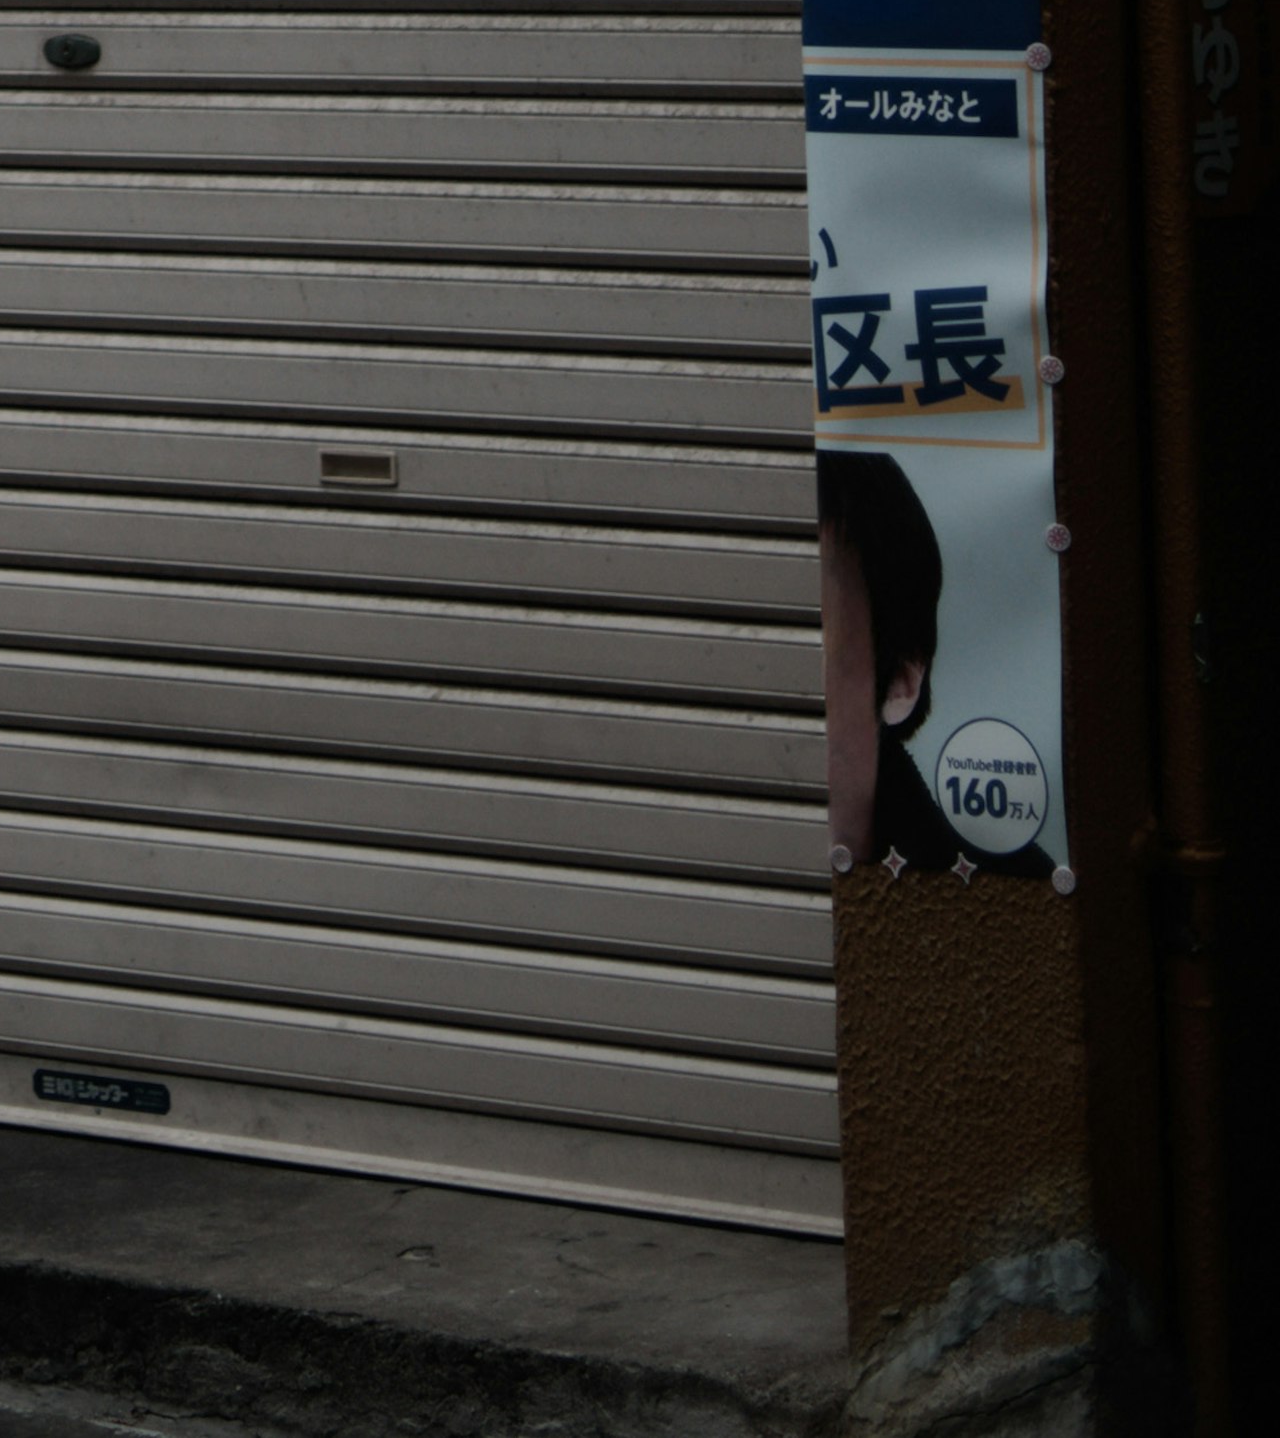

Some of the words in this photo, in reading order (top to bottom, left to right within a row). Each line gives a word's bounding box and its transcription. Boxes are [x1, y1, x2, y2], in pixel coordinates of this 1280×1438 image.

[819, 87, 983, 124] オールみなと
[812, 285, 1011, 413] 区長
